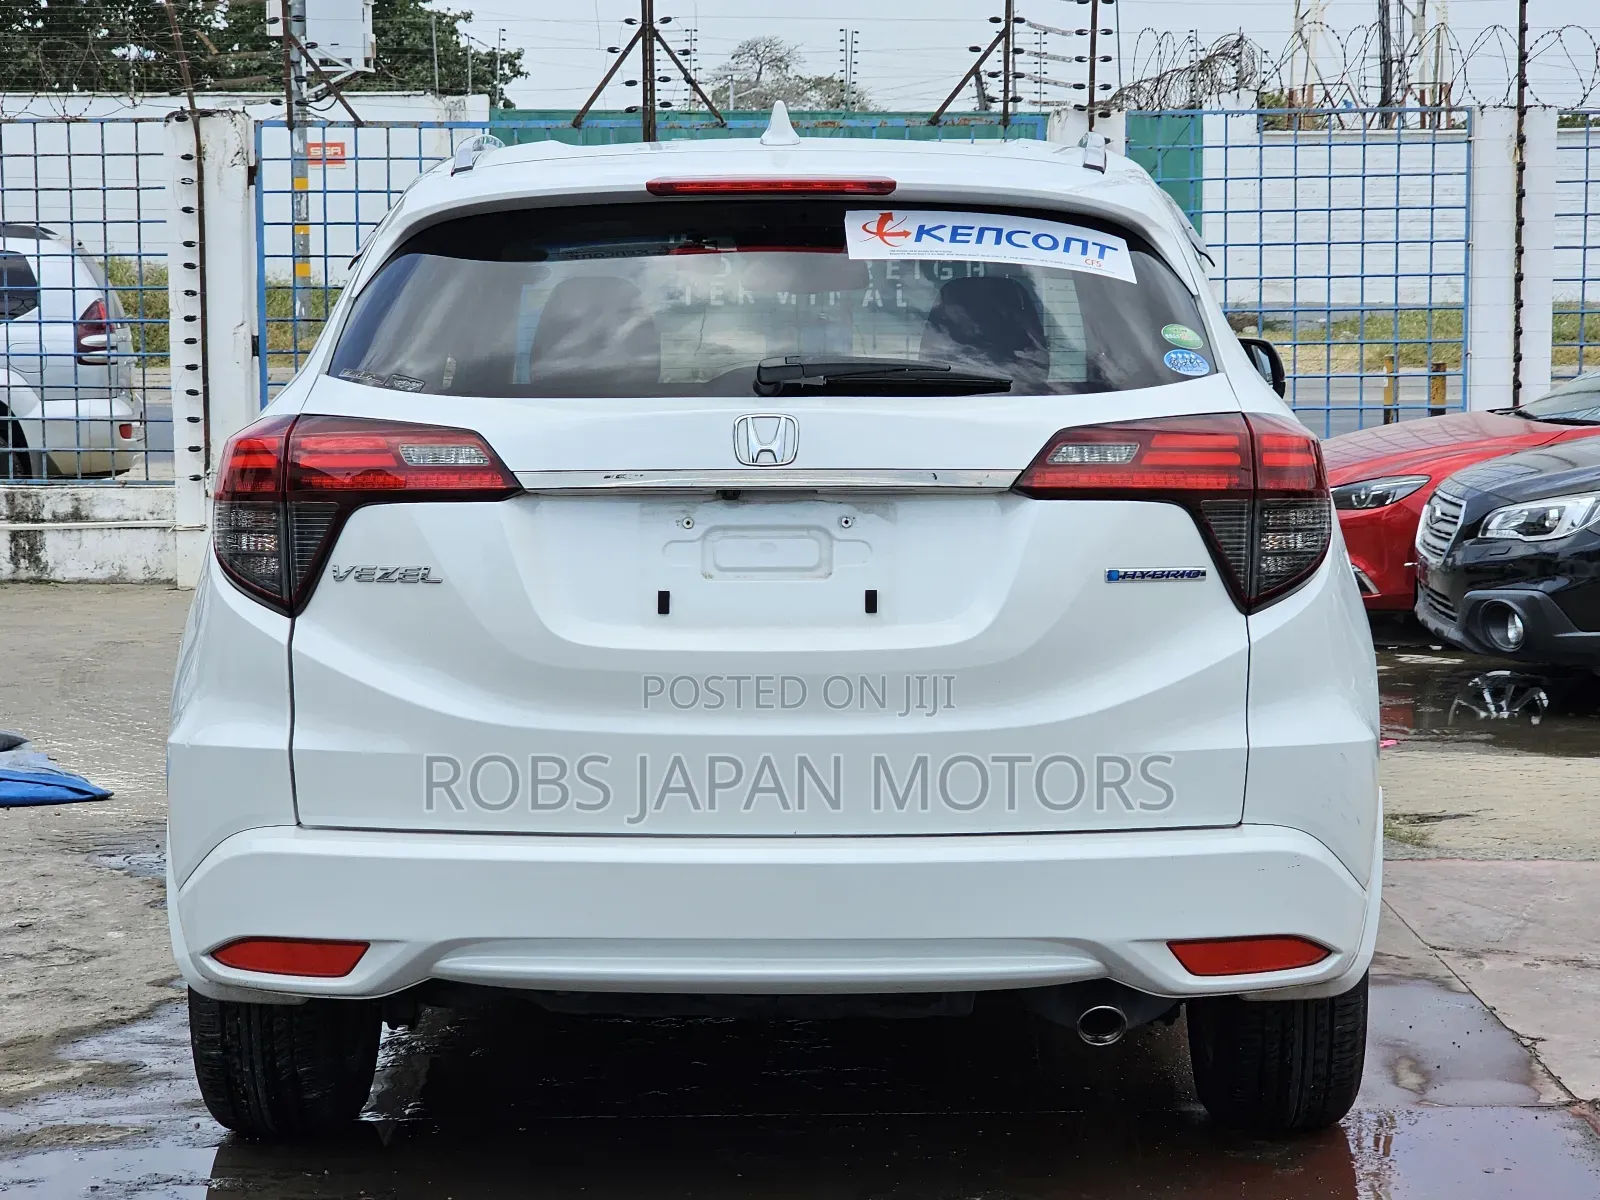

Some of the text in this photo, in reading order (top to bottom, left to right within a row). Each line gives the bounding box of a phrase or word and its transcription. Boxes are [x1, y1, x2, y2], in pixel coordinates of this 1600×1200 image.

[1084, 257, 1103, 268] CFS
[332, 564, 444, 584] VEZEL
[1119, 569, 1202, 580] HYBRID
